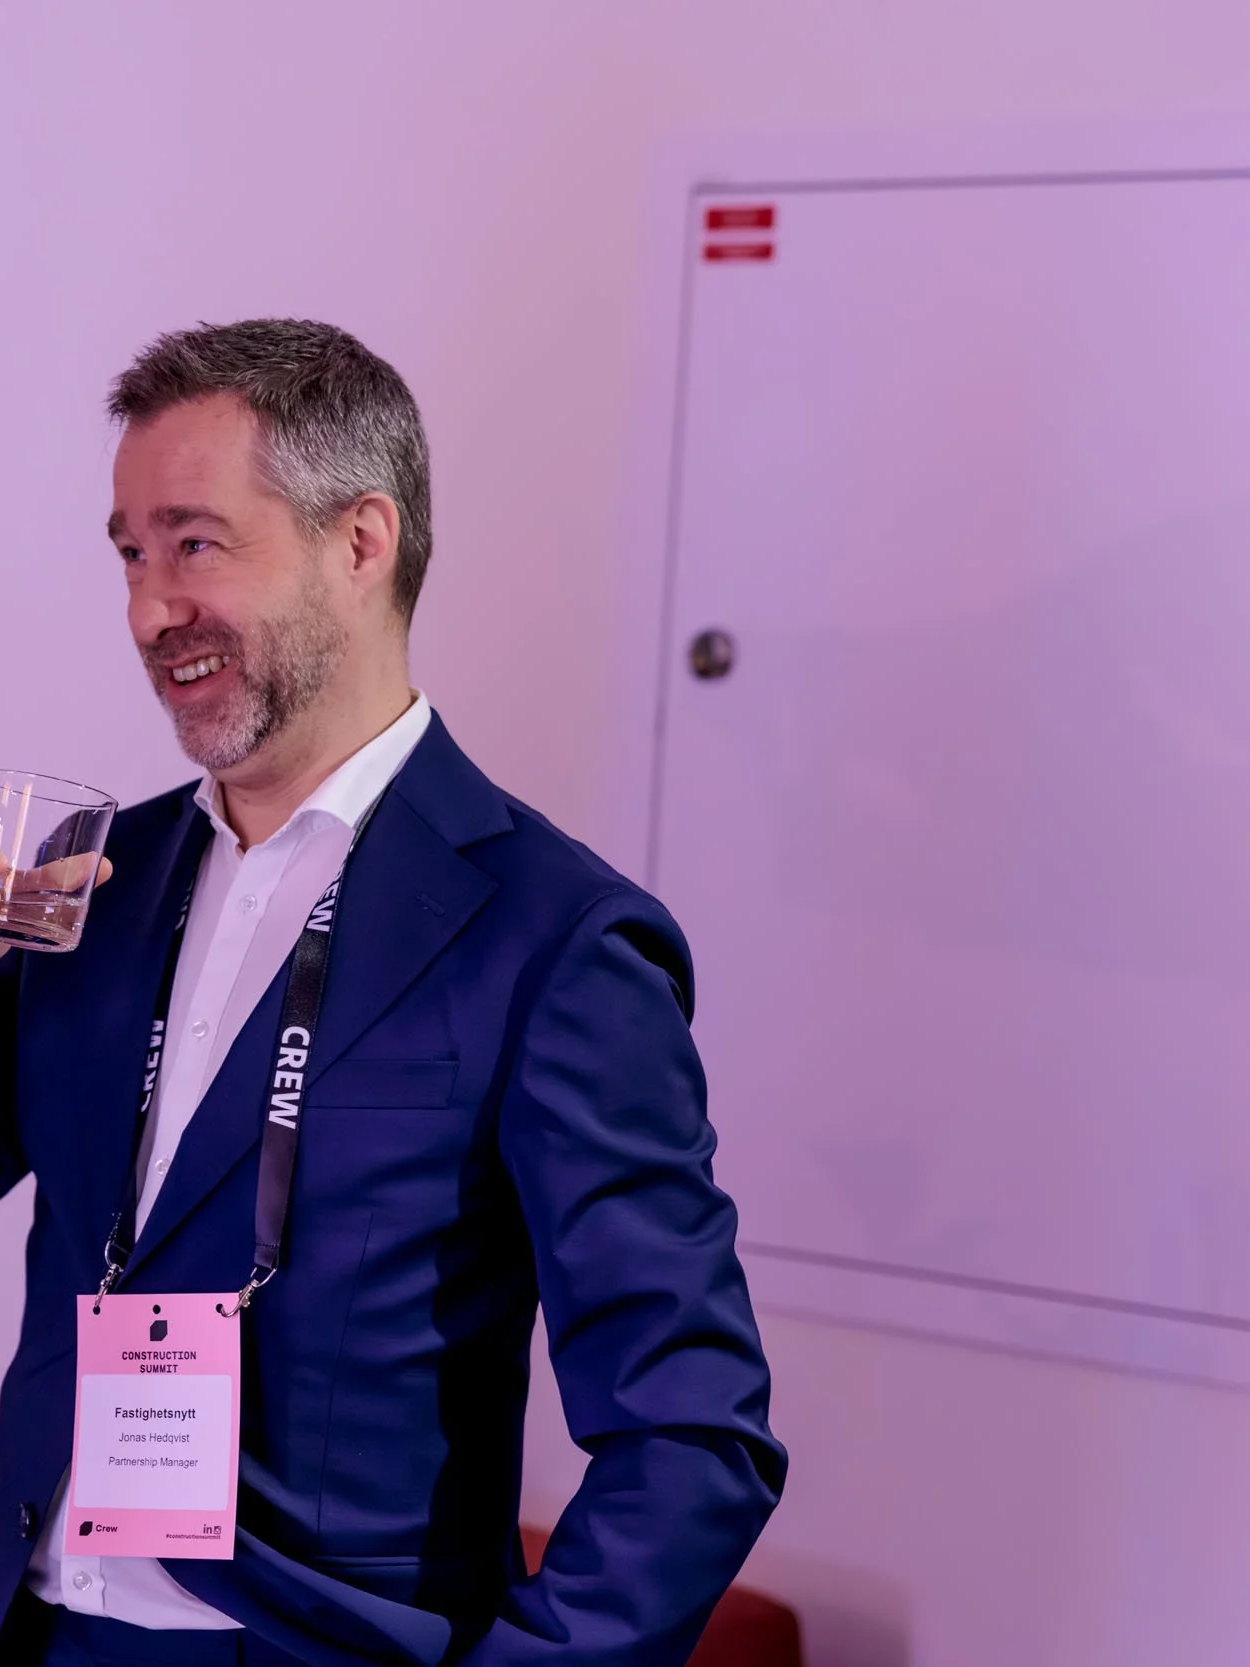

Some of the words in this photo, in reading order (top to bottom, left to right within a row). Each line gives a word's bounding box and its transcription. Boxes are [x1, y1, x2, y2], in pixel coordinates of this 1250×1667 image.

[306, 870, 342, 932] EW
[268, 1026, 310, 1130] CREW
[121, 1350, 197, 1361] CONSTRUCTION
[139, 1364, 178, 1373] SUMMIT
[114, 1407, 196, 1421] Fastighetsnytt
[118, 1432, 147, 1443] Jonas
[149, 1432, 190, 1445] Hedqvist
[108, 1456, 158, 1467] Partnership
[159, 1457, 199, 1469] Manager
[95, 1524, 118, 1533] Crew
